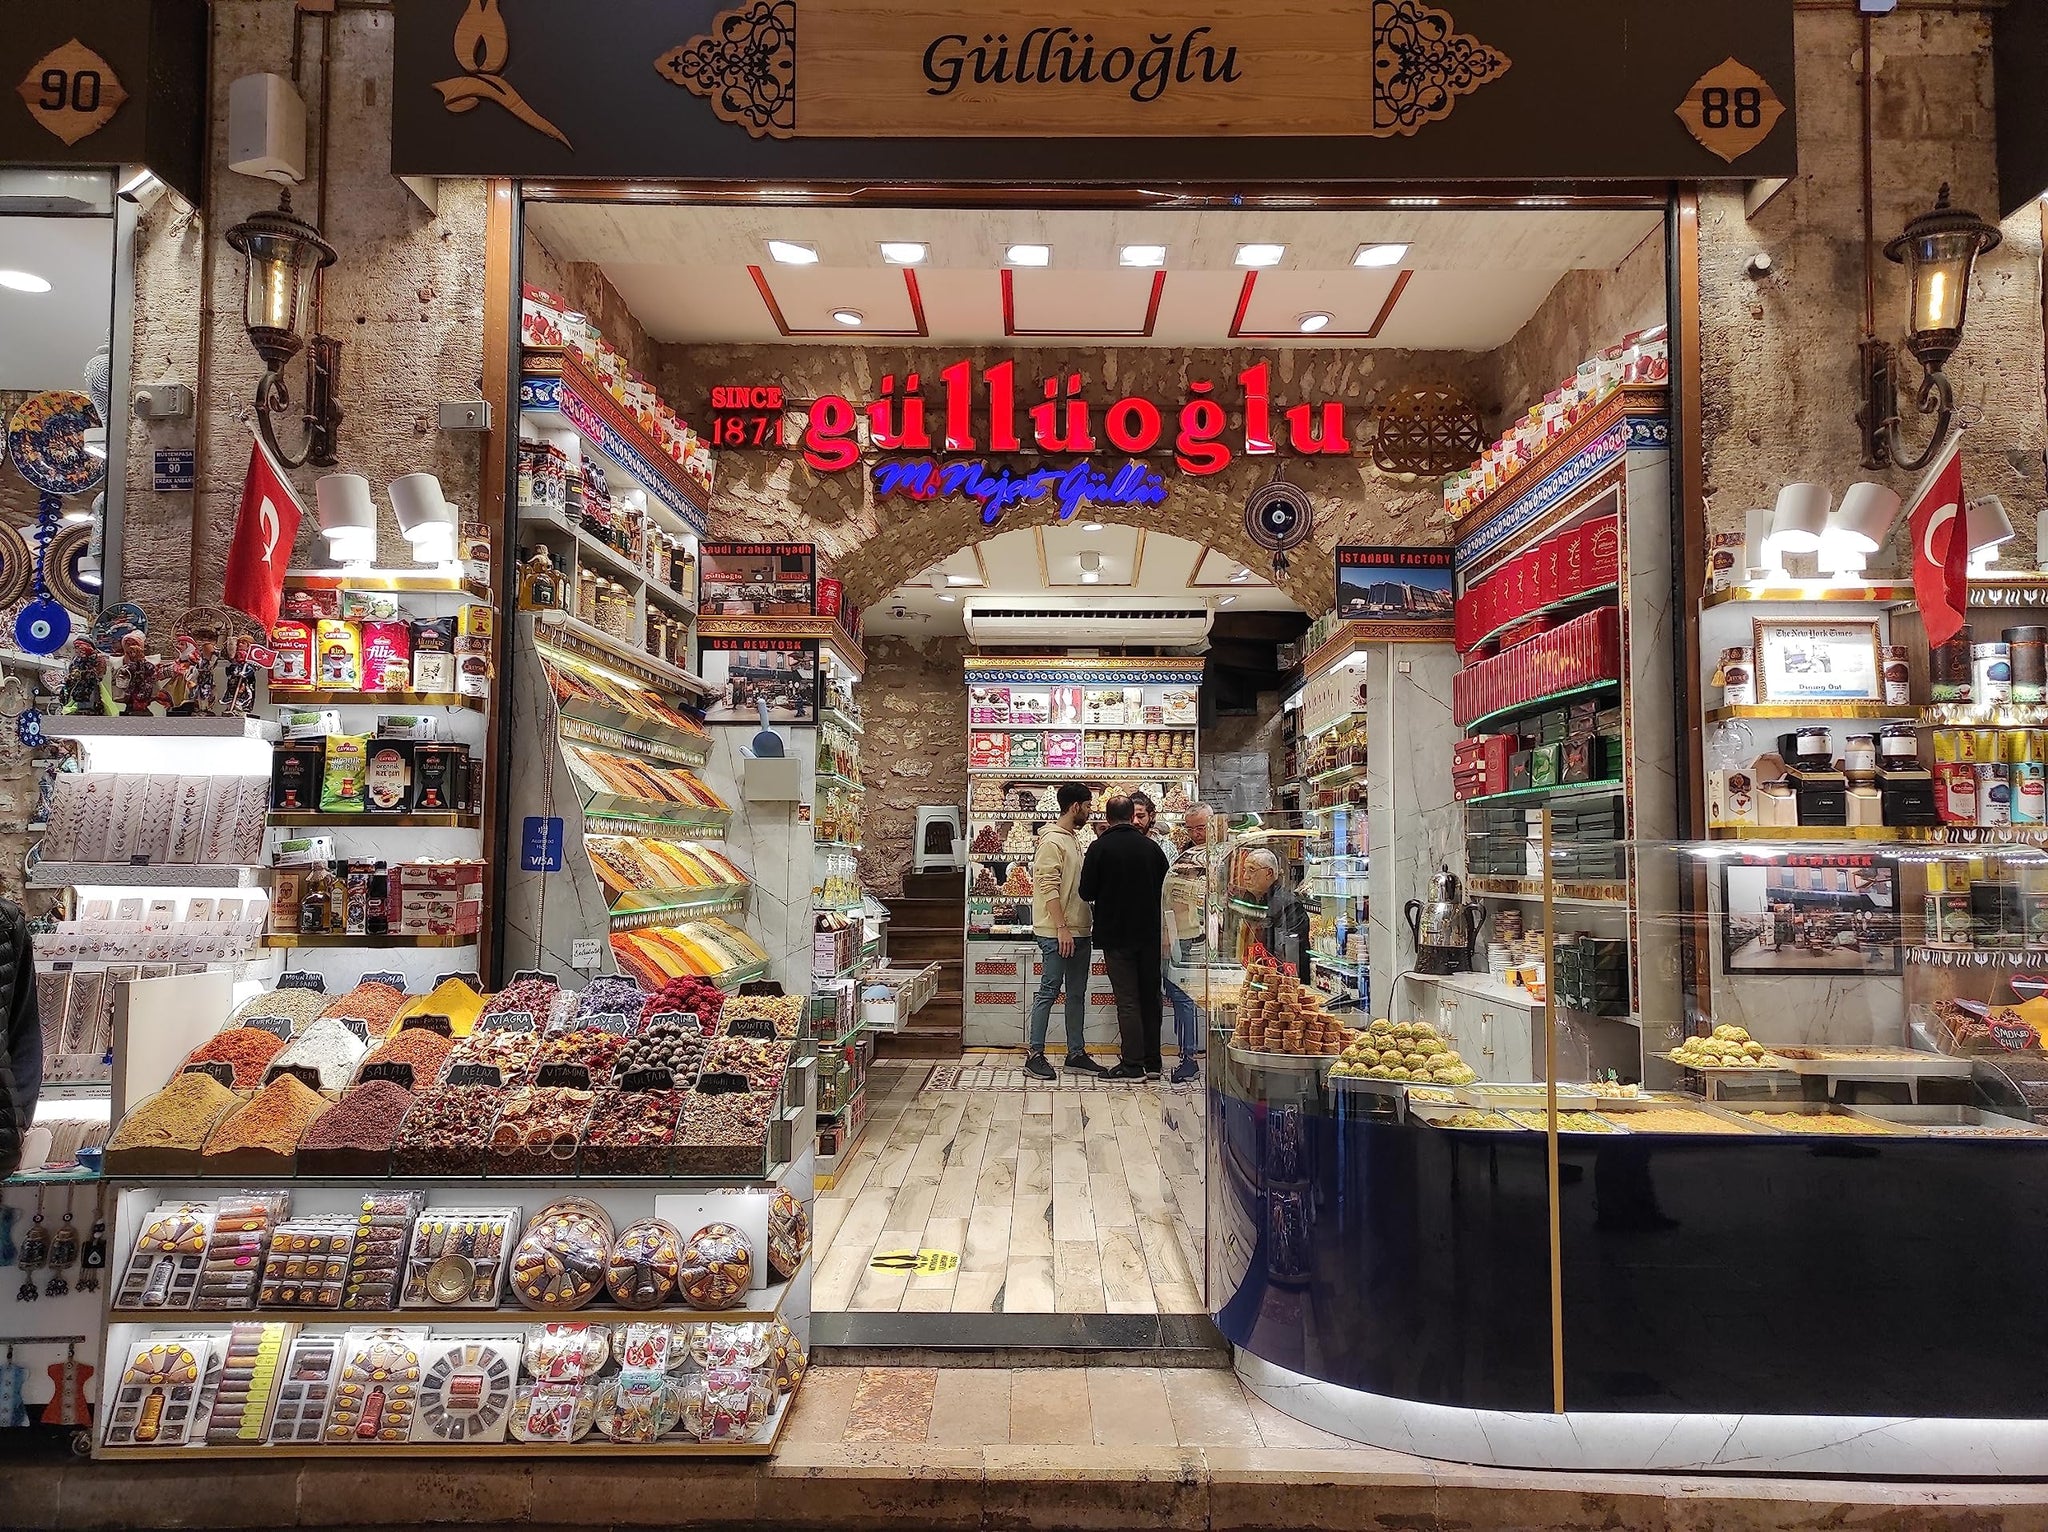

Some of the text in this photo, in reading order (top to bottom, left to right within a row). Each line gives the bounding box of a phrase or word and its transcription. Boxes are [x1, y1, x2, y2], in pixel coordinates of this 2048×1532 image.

[922, 27, 1242, 102] Güllüoğlu
[39, 69, 101, 112] 90
[1702, 87, 1761, 128] 88
[711, 386, 784, 409] SINCE
[803, 359, 1350, 475] güllüoğlu
[712, 416, 785, 446] 1871
[168, 464, 180, 473] 90
[940, 461, 1066, 526] Nejat
[1057, 462, 1169, 521] Güllü
[1400, 553, 1451, 566] FACTORY
[713, 640, 738, 649] USA
[491, 1015, 529, 1025] VIAGRA
[588, 1017, 613, 1026] LOVE
[736, 1021, 770, 1031] WINTER
[1993, 1026, 2030, 1039] SMOKED
[365, 1065, 408, 1078] SALAD
[461, 1066, 494, 1077] RELAX
